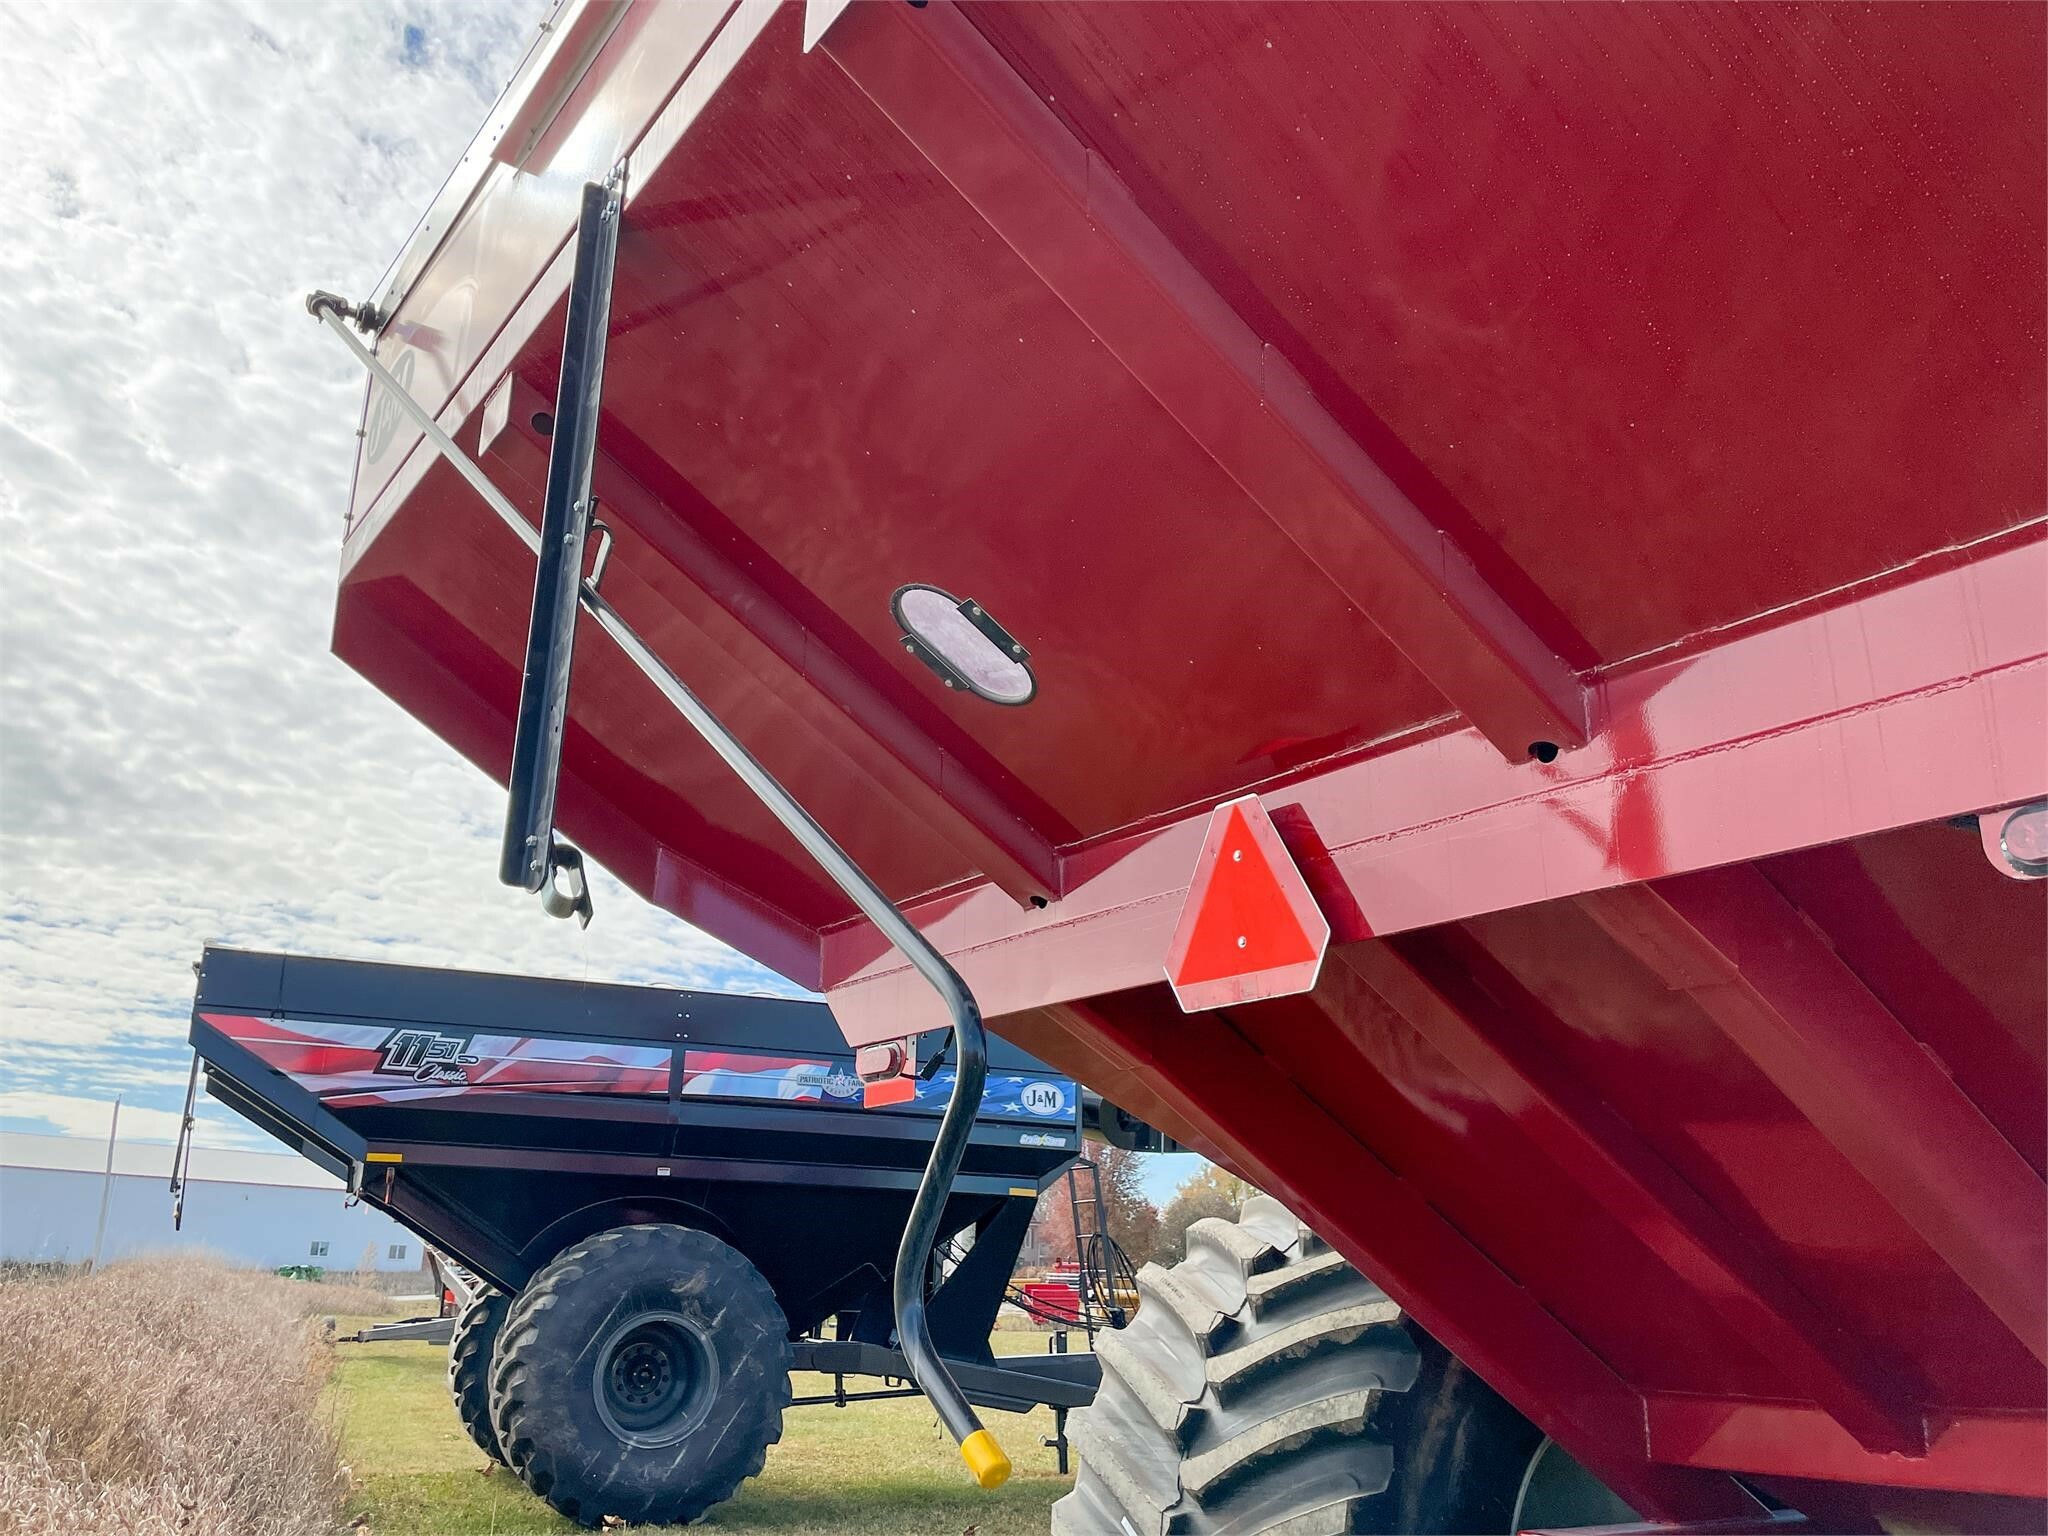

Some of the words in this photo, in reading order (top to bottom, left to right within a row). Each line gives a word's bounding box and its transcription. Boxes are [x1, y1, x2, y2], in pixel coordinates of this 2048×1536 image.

[414, 1063, 467, 1082] Classic
[799, 1076, 834, 1085] PATRIOTIC
[1026, 1089, 1057, 1108] J&M
